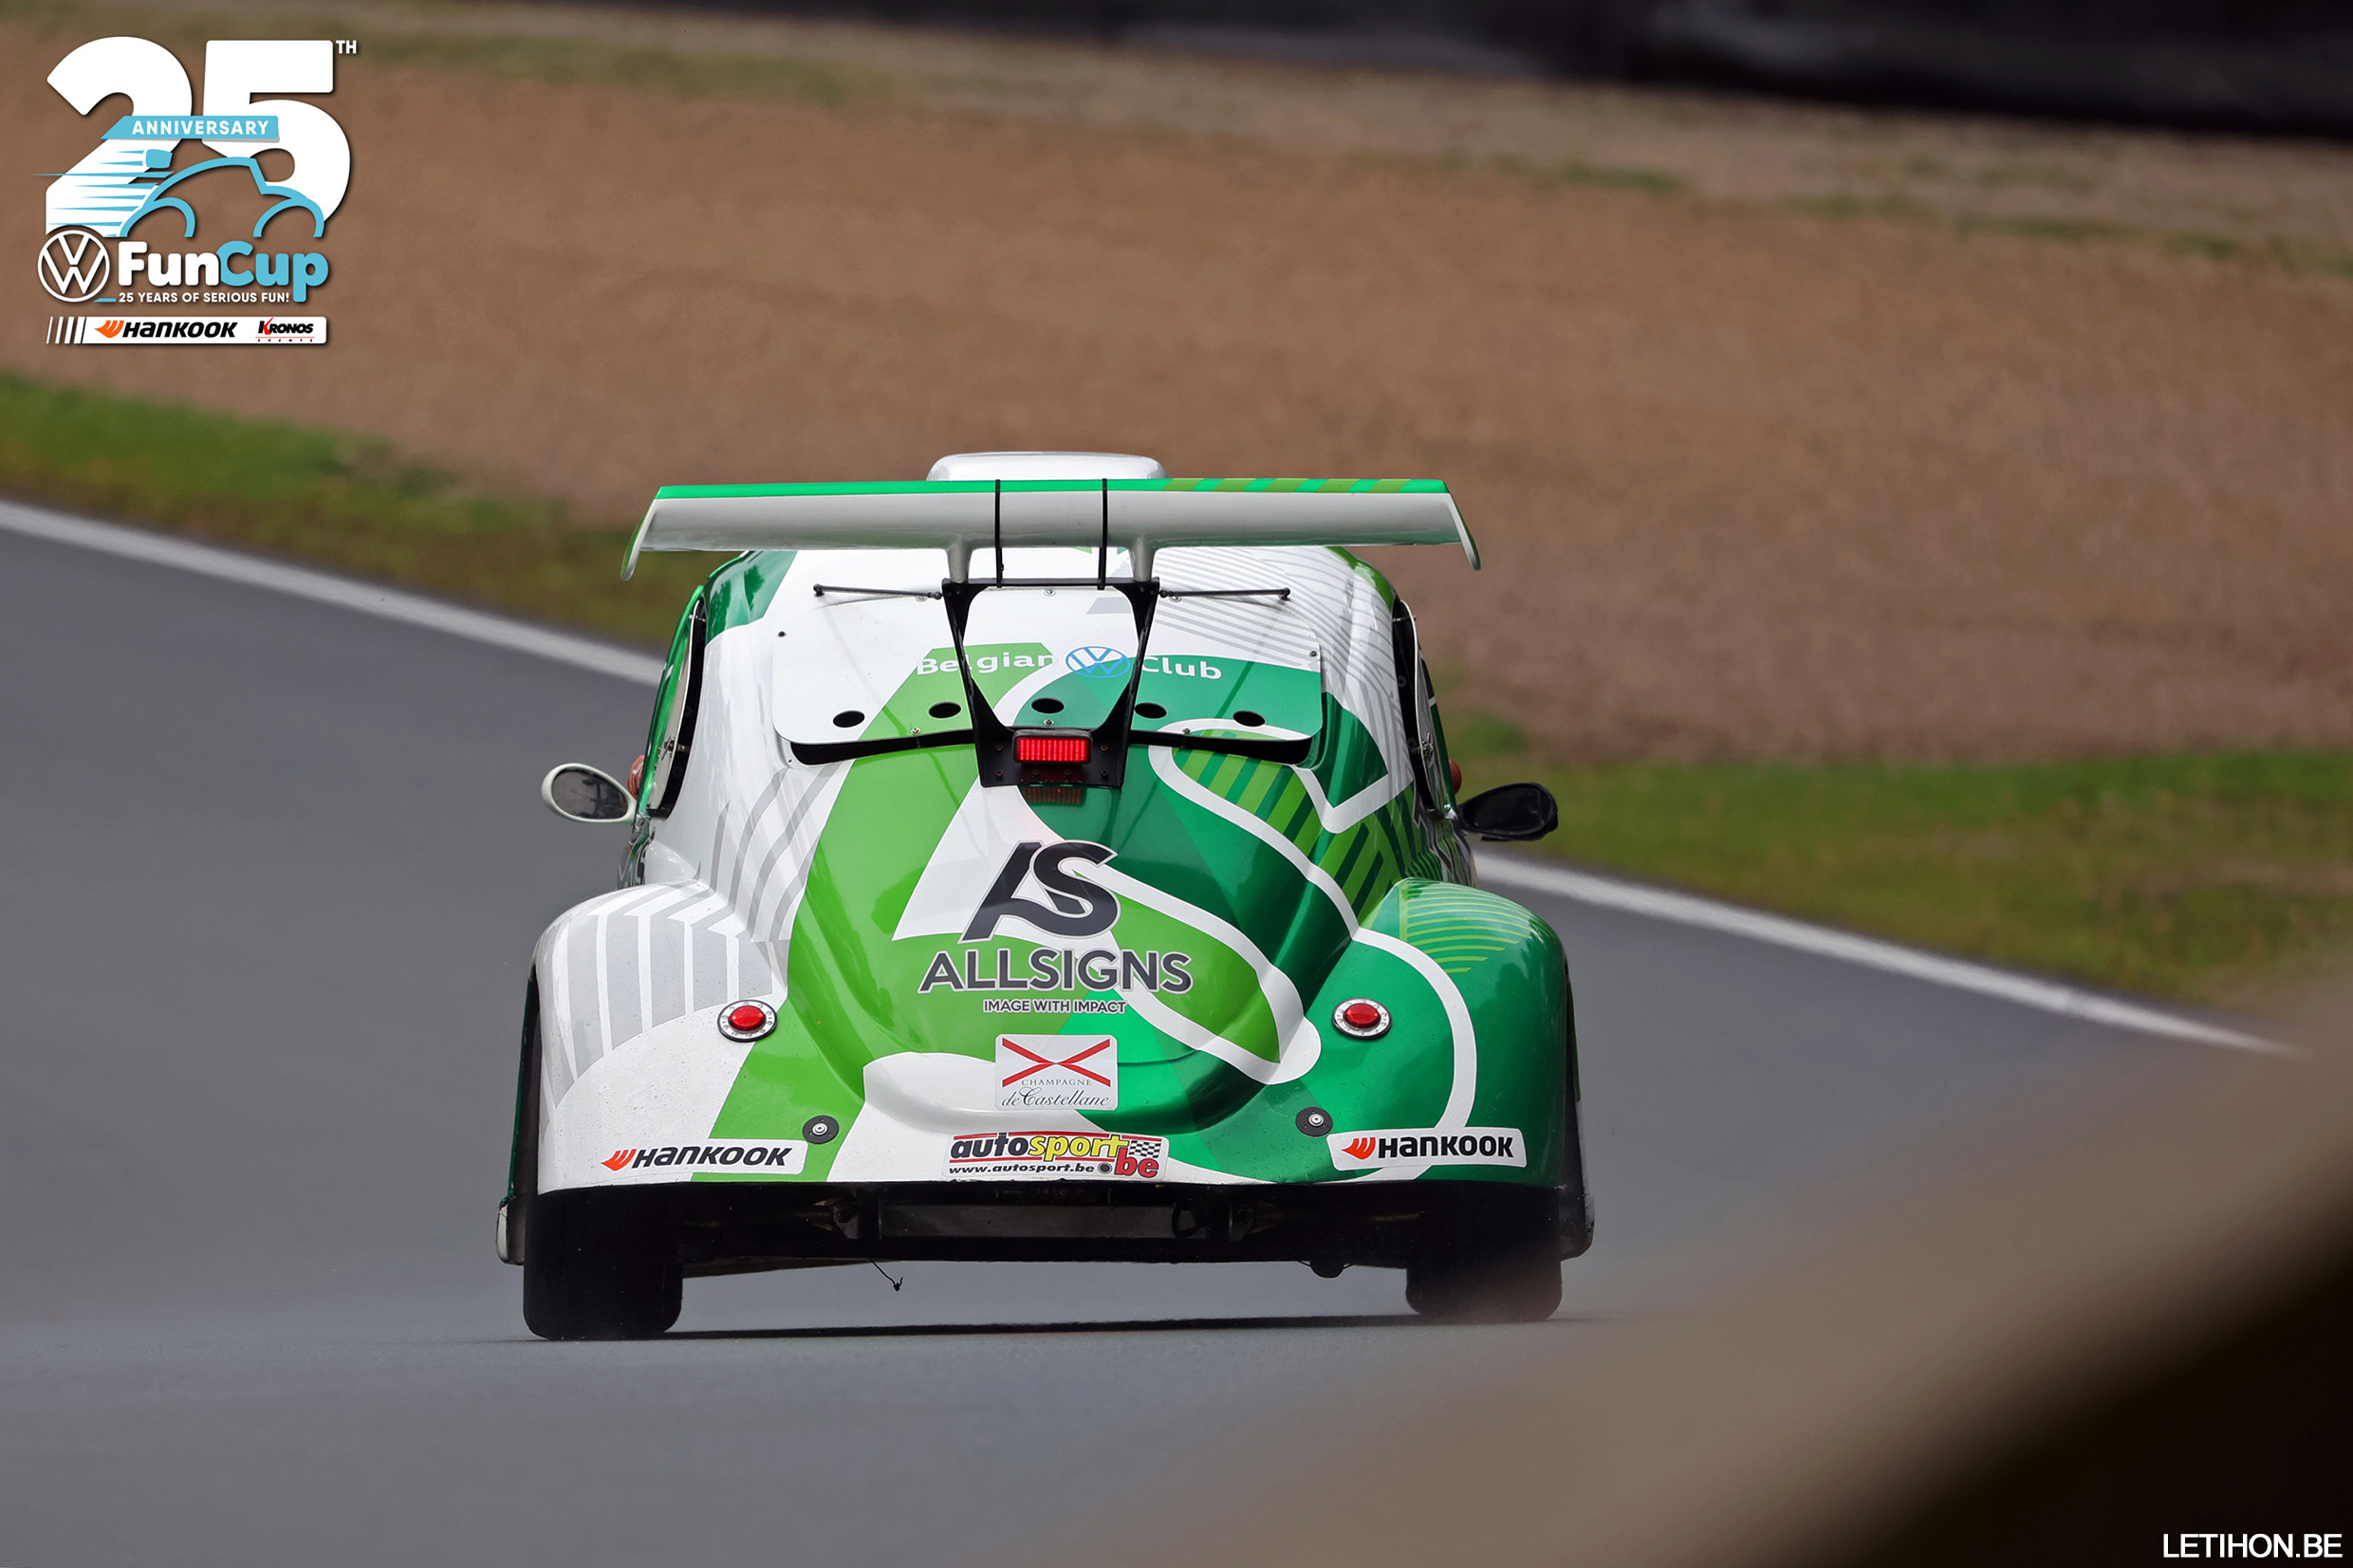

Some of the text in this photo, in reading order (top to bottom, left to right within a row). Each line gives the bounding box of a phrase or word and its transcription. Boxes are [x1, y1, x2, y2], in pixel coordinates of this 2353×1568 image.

[1141, 655, 1222, 679] Club
[919, 949, 1193, 992] ALLSIGNS
[984, 1000, 1126, 1013] IMAGE WITH IMPACT
[1001, 1086, 1111, 1108] de Castellane
[950, 1133, 1128, 1162] autosport
[949, 1162, 1095, 1174] www.autosport.be
[1114, 1147, 1159, 1178] be
